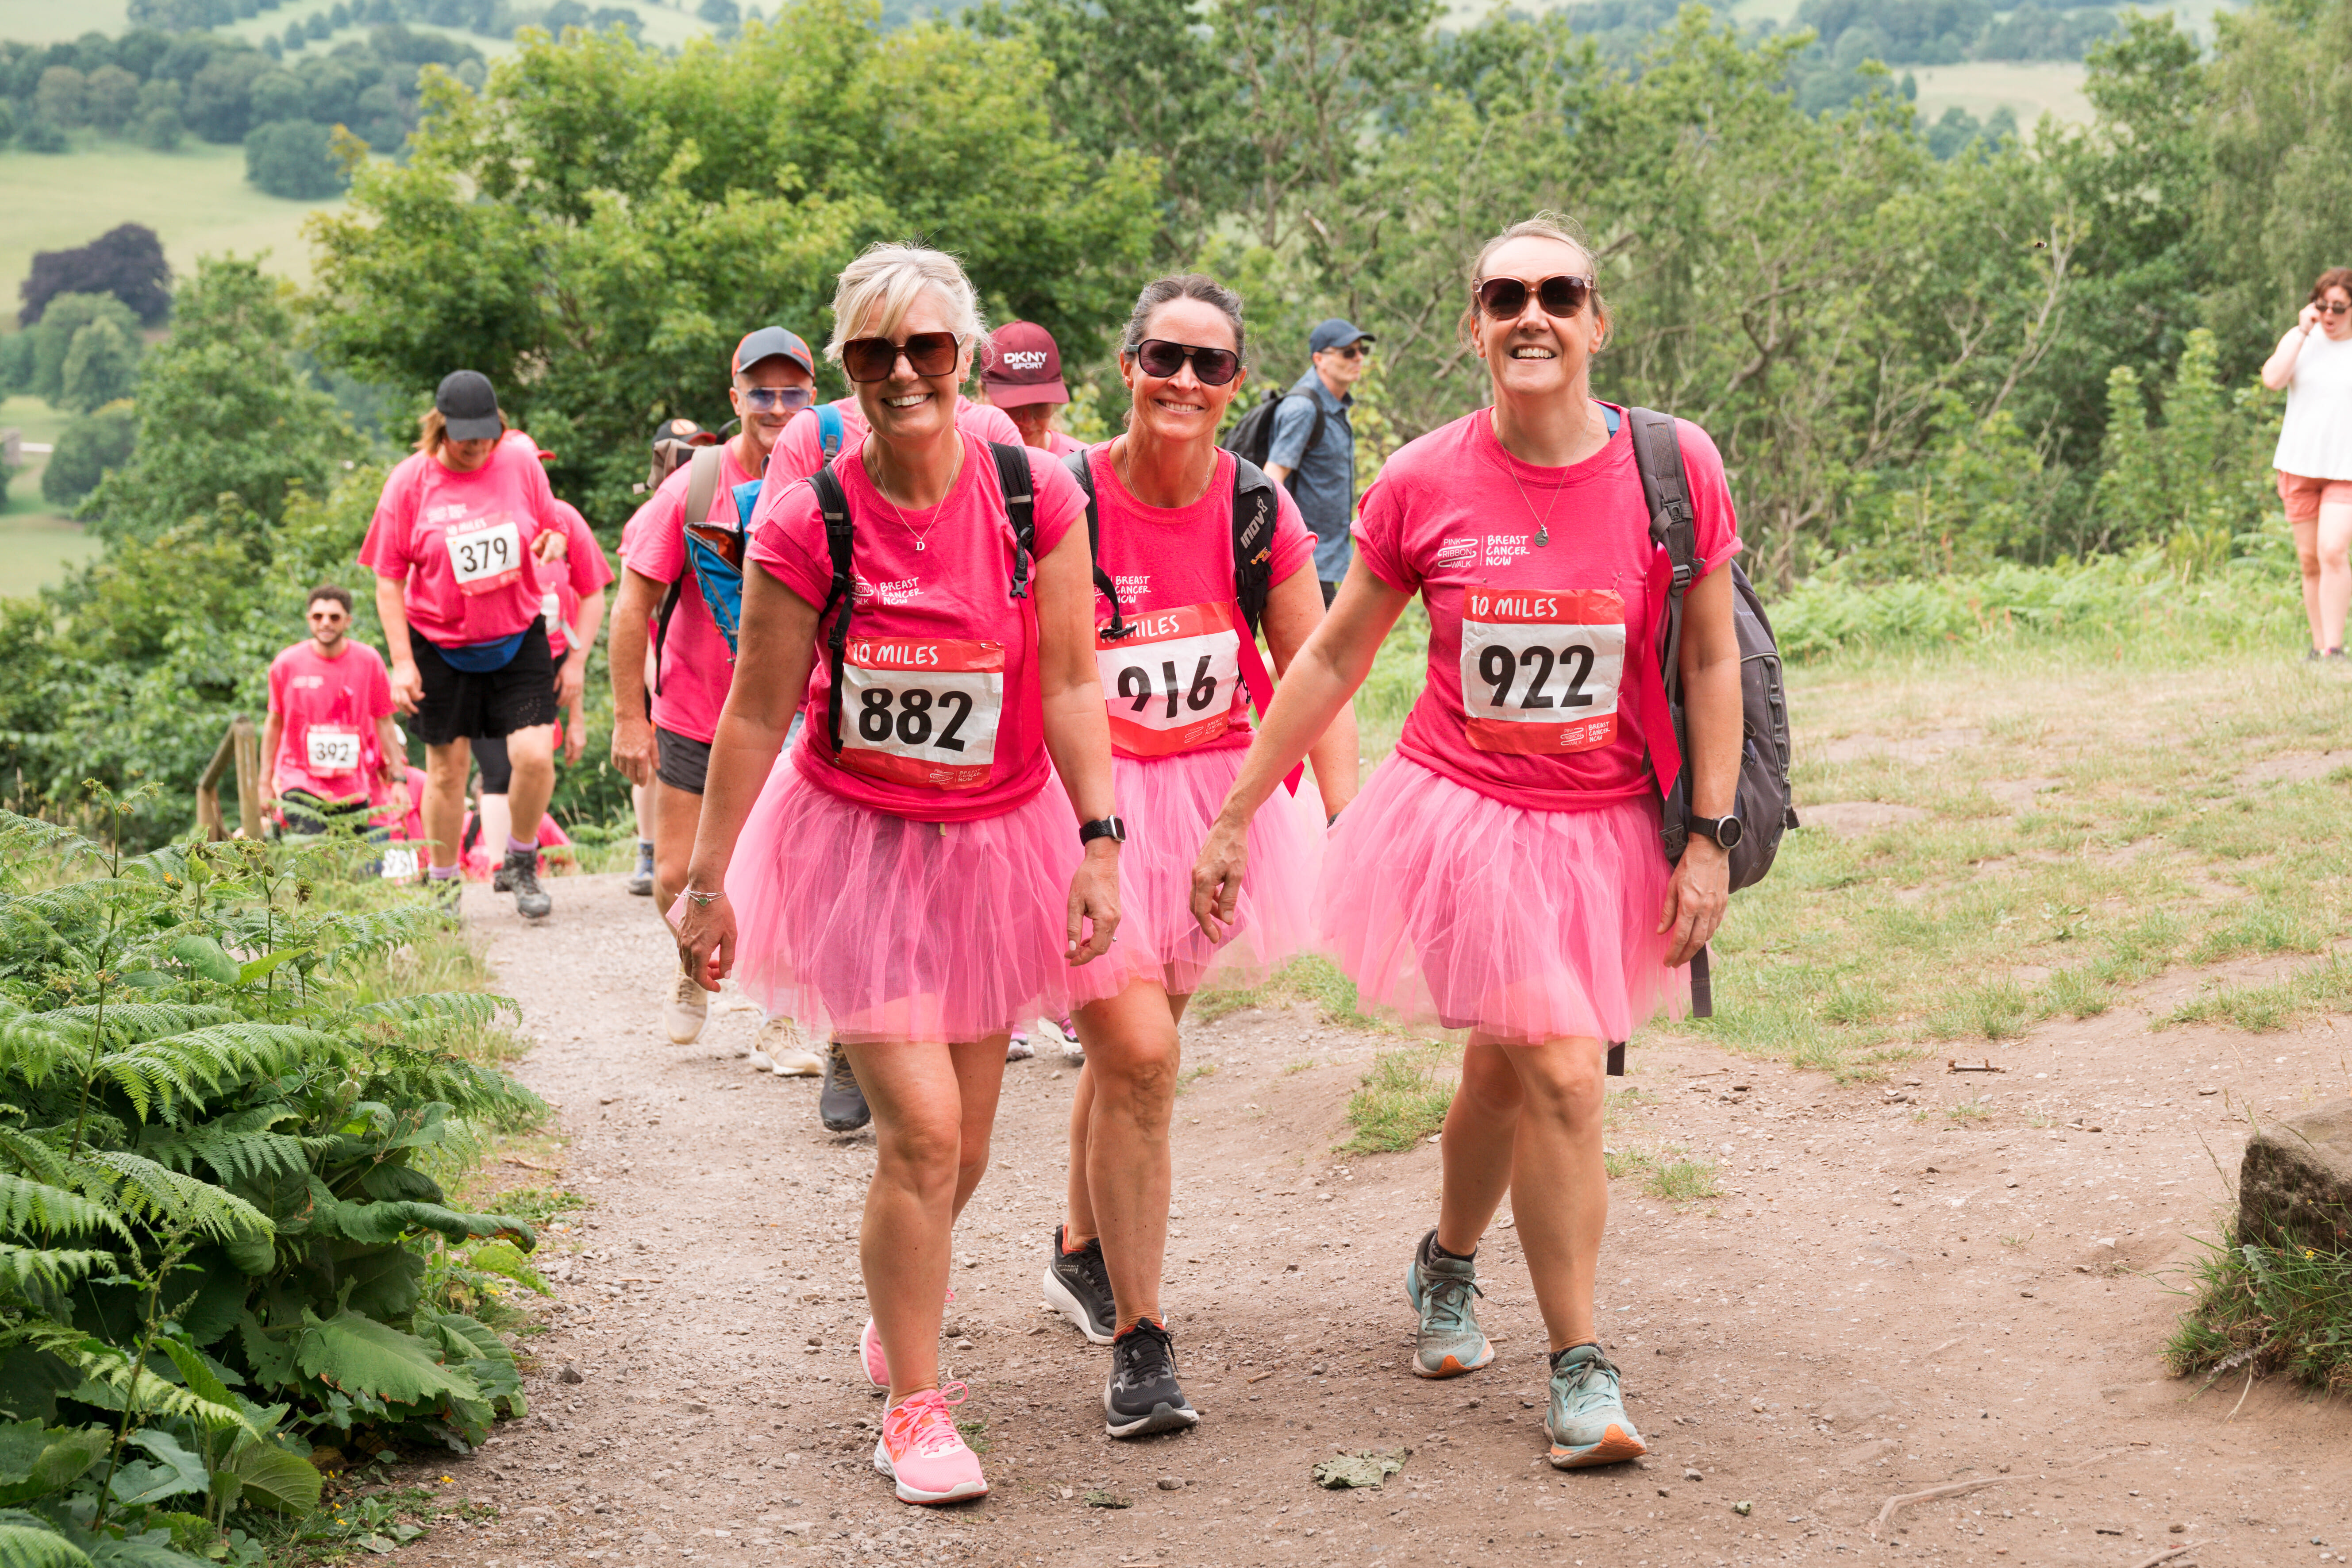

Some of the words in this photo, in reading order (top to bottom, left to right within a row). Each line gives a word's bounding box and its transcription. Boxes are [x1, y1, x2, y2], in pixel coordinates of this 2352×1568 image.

[1004, 351, 1047, 364] DKNY
[1444, 537, 1461, 546] PINK
[1487, 535, 1529, 546] BREAST
[460, 537, 508, 572] 379
[1443, 548, 1472, 558] RIBBON
[1486, 546, 1530, 555] CANCER
[1450, 560, 1471, 569] WALK
[1486, 556, 1511, 566] NOW
[880, 577, 919, 592] BREAST
[1116, 575, 1151, 585] BREAST
[882, 588, 924, 598] CANCER
[1115, 586, 1151, 594] CANCER
[883, 597, 907, 605] NOW
[1118, 595, 1136, 604] NOW
[1471, 595, 1489, 616] 10
[1494, 597, 1558, 617] MILES
[1124, 615, 1179, 640] MILES
[853, 643, 870, 663] 10
[876, 645, 939, 665] MILES
[1479, 645, 1594, 709] 922
[1117, 655, 1217, 719] 916
[859, 688, 973, 752] 882
[1207, 717, 1224, 728] BREAST
[1589, 721, 1610, 731] BREAST
[1589, 728, 1611, 736] CANCER
[316, 742, 348, 761] 392
